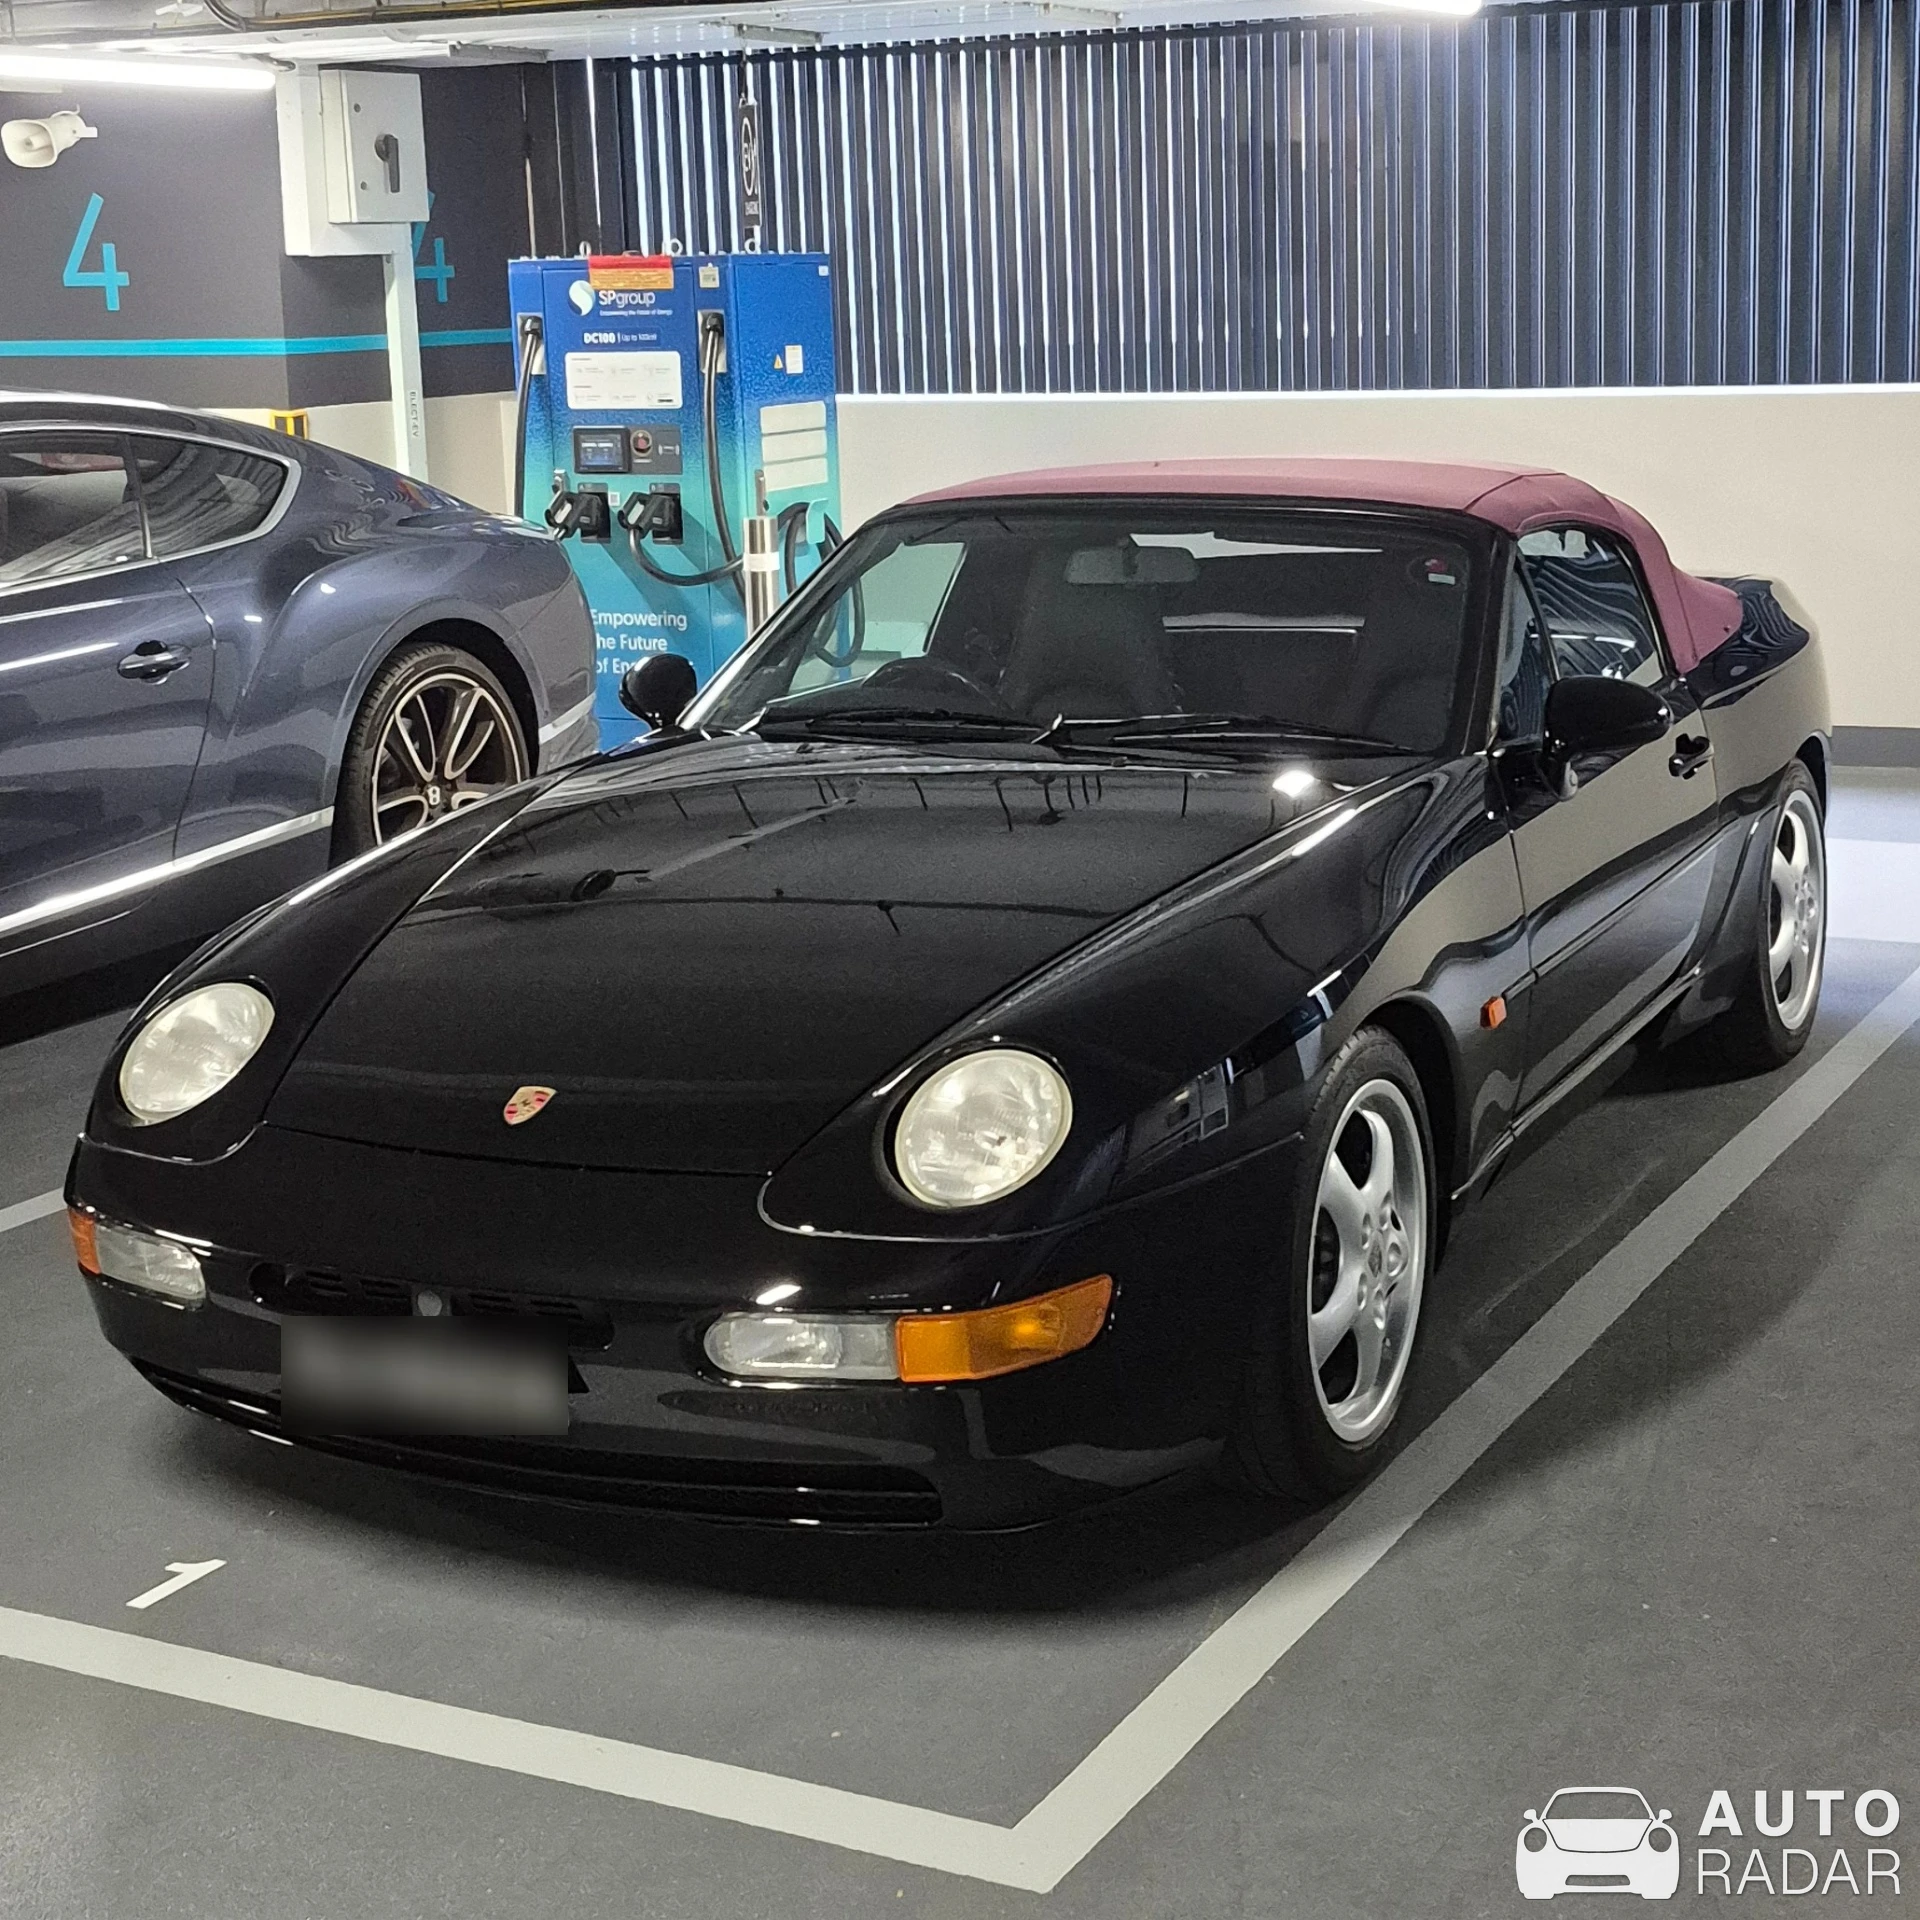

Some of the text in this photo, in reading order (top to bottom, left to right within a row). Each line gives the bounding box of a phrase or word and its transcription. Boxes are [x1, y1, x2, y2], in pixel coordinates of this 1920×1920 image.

[63, 192, 130, 312] 4
[412, 190, 455, 302] 4
[583, 332, 616, 344] DC100
[590, 609, 687, 631] Empowering
[596, 633, 668, 650] he Future
[126, 1559, 227, 1609] 1
